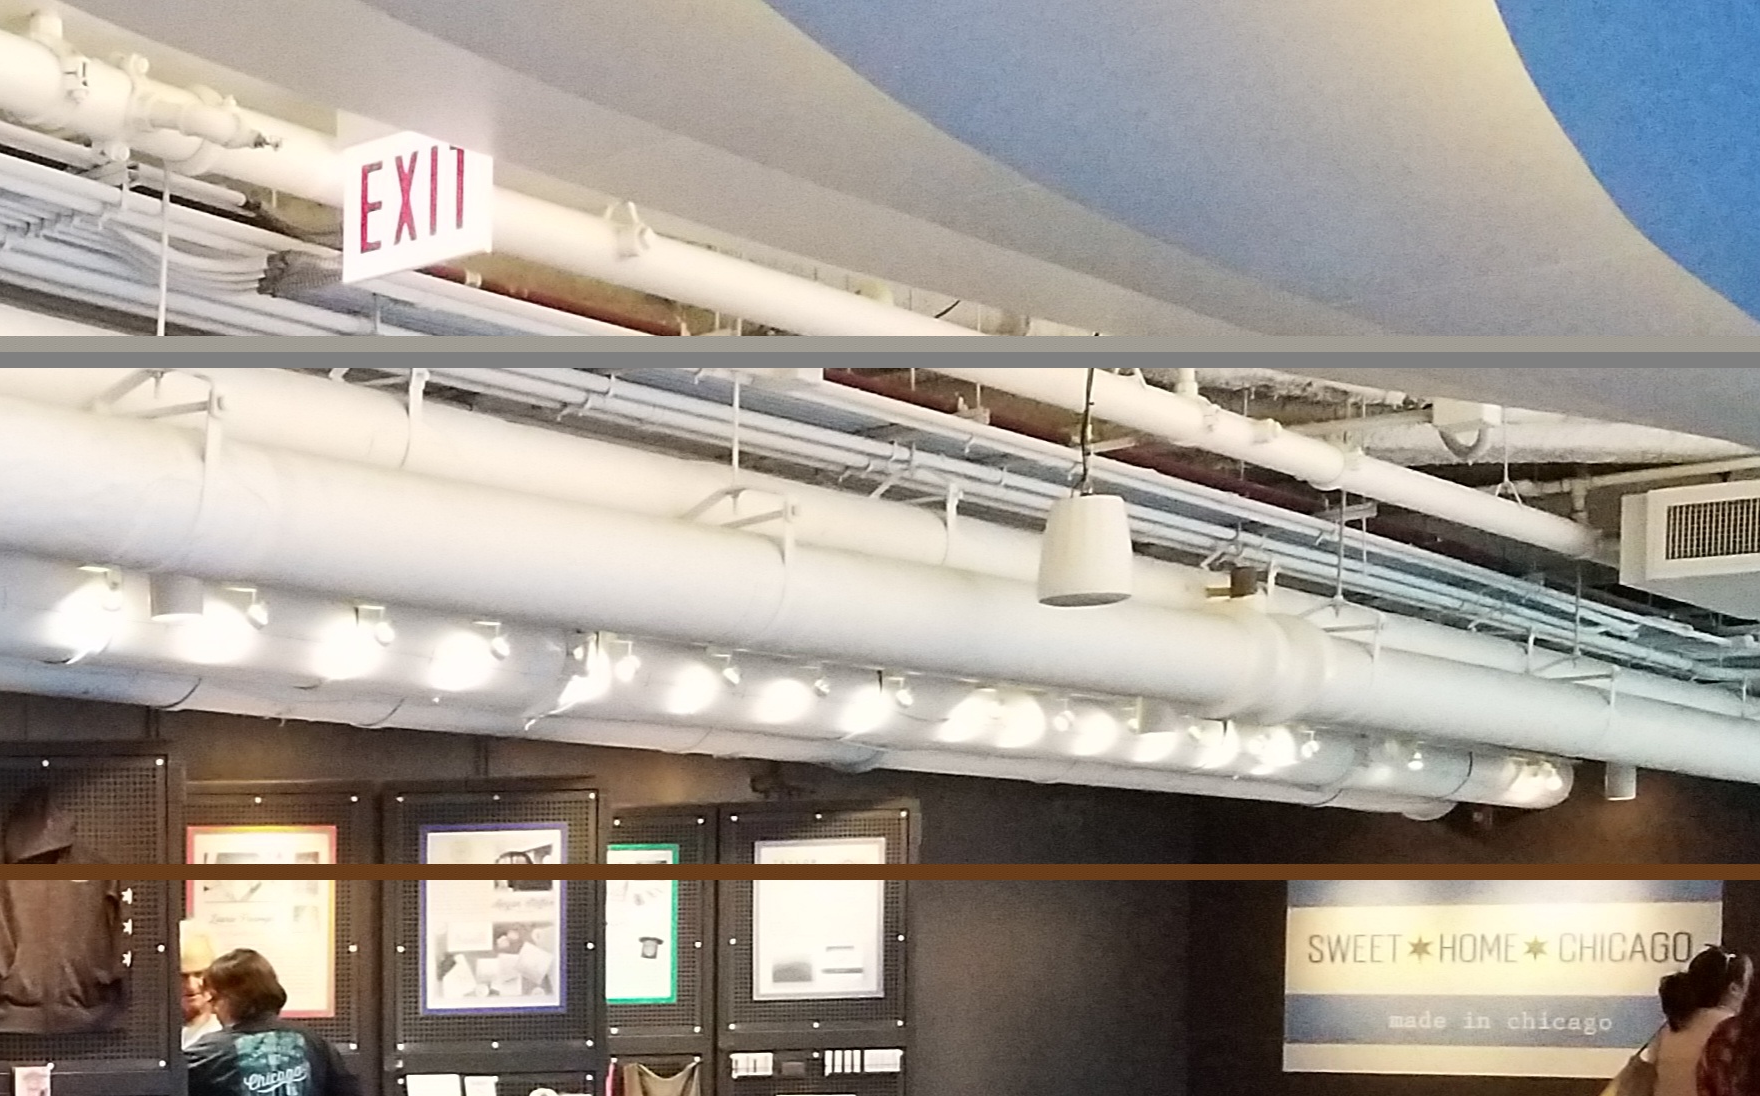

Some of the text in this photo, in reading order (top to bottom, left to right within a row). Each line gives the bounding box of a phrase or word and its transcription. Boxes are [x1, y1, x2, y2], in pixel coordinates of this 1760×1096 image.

[360, 146, 465, 254] EXIT
[1307, 931, 1692, 964] SWEET HOME CHICAGO
[1387, 1010, 1614, 1036] made in chicago
[243, 1066, 307, 1092] Chicago
